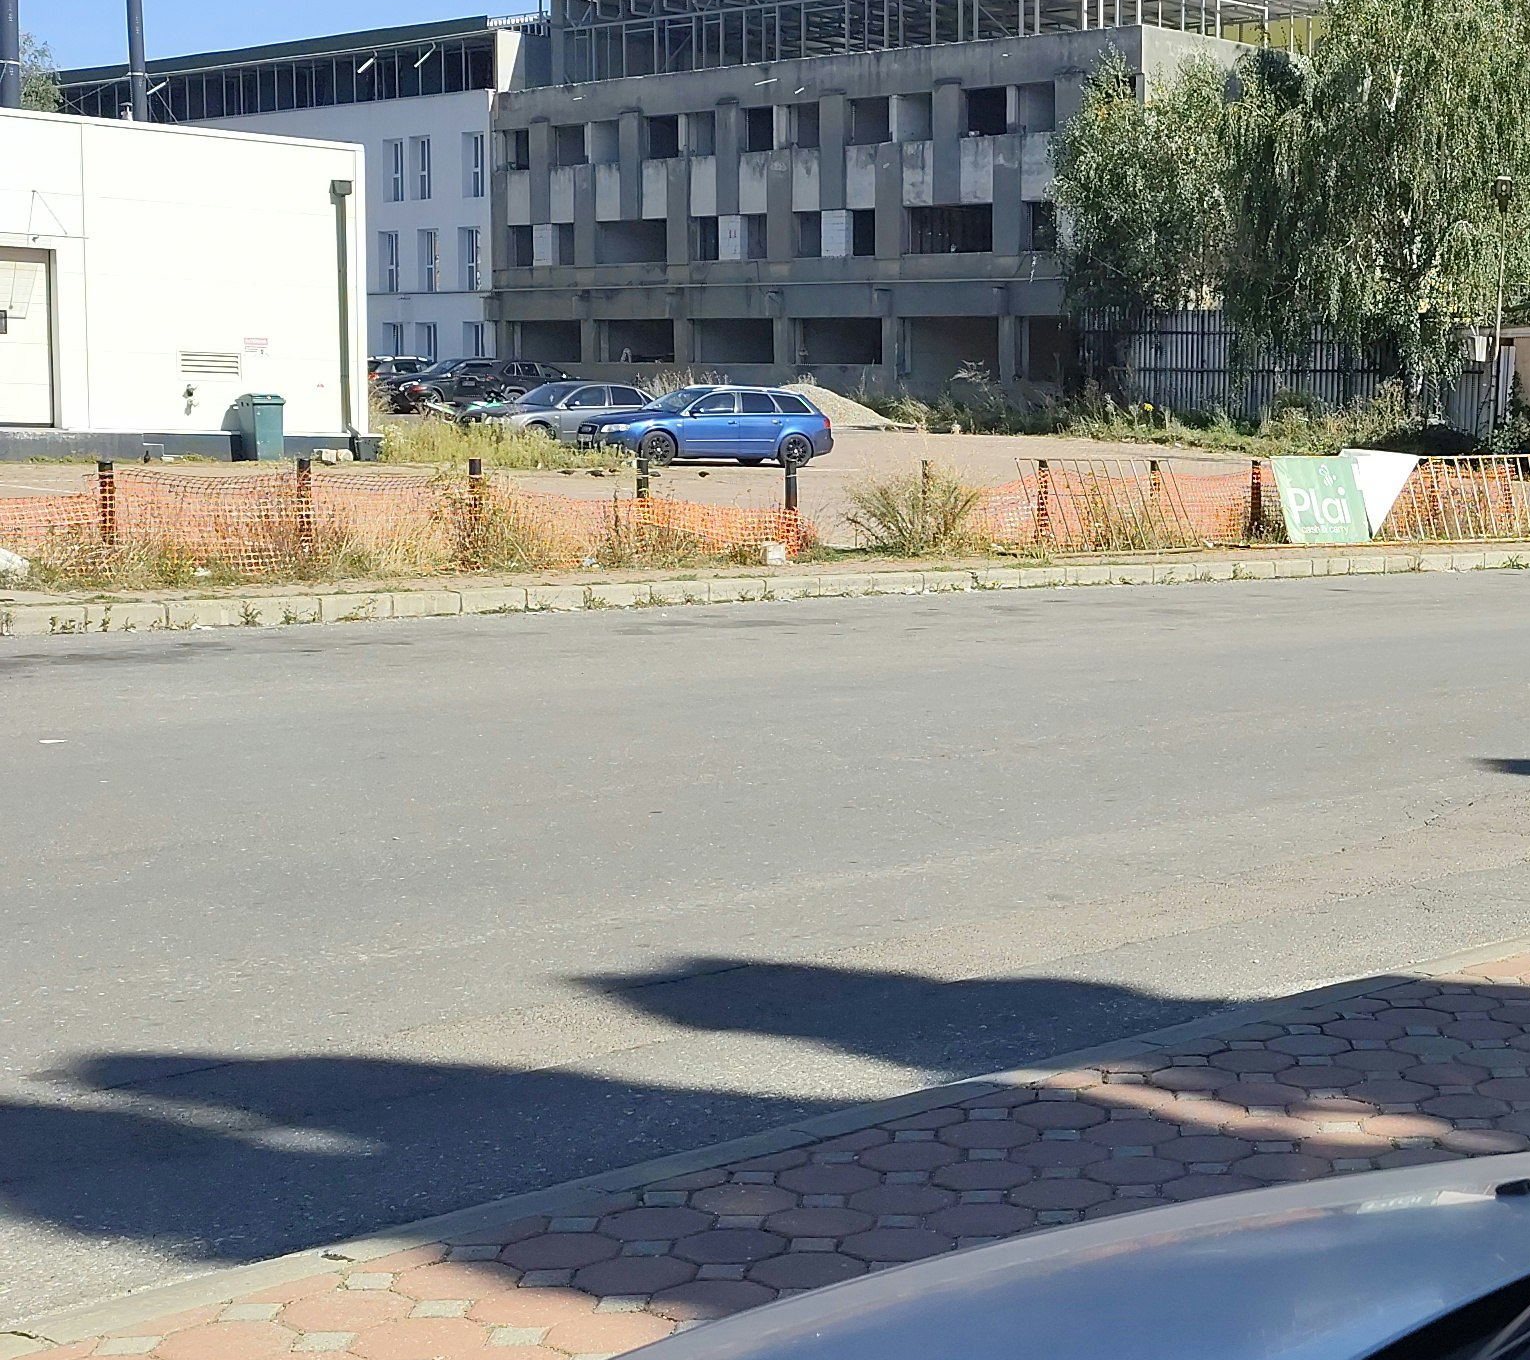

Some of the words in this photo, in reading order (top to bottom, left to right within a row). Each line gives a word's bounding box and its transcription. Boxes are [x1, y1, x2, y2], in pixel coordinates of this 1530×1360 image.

[1286, 486, 1352, 524] Plai
[1301, 525, 1320, 534] cash
[1328, 525, 1349, 536] carry
